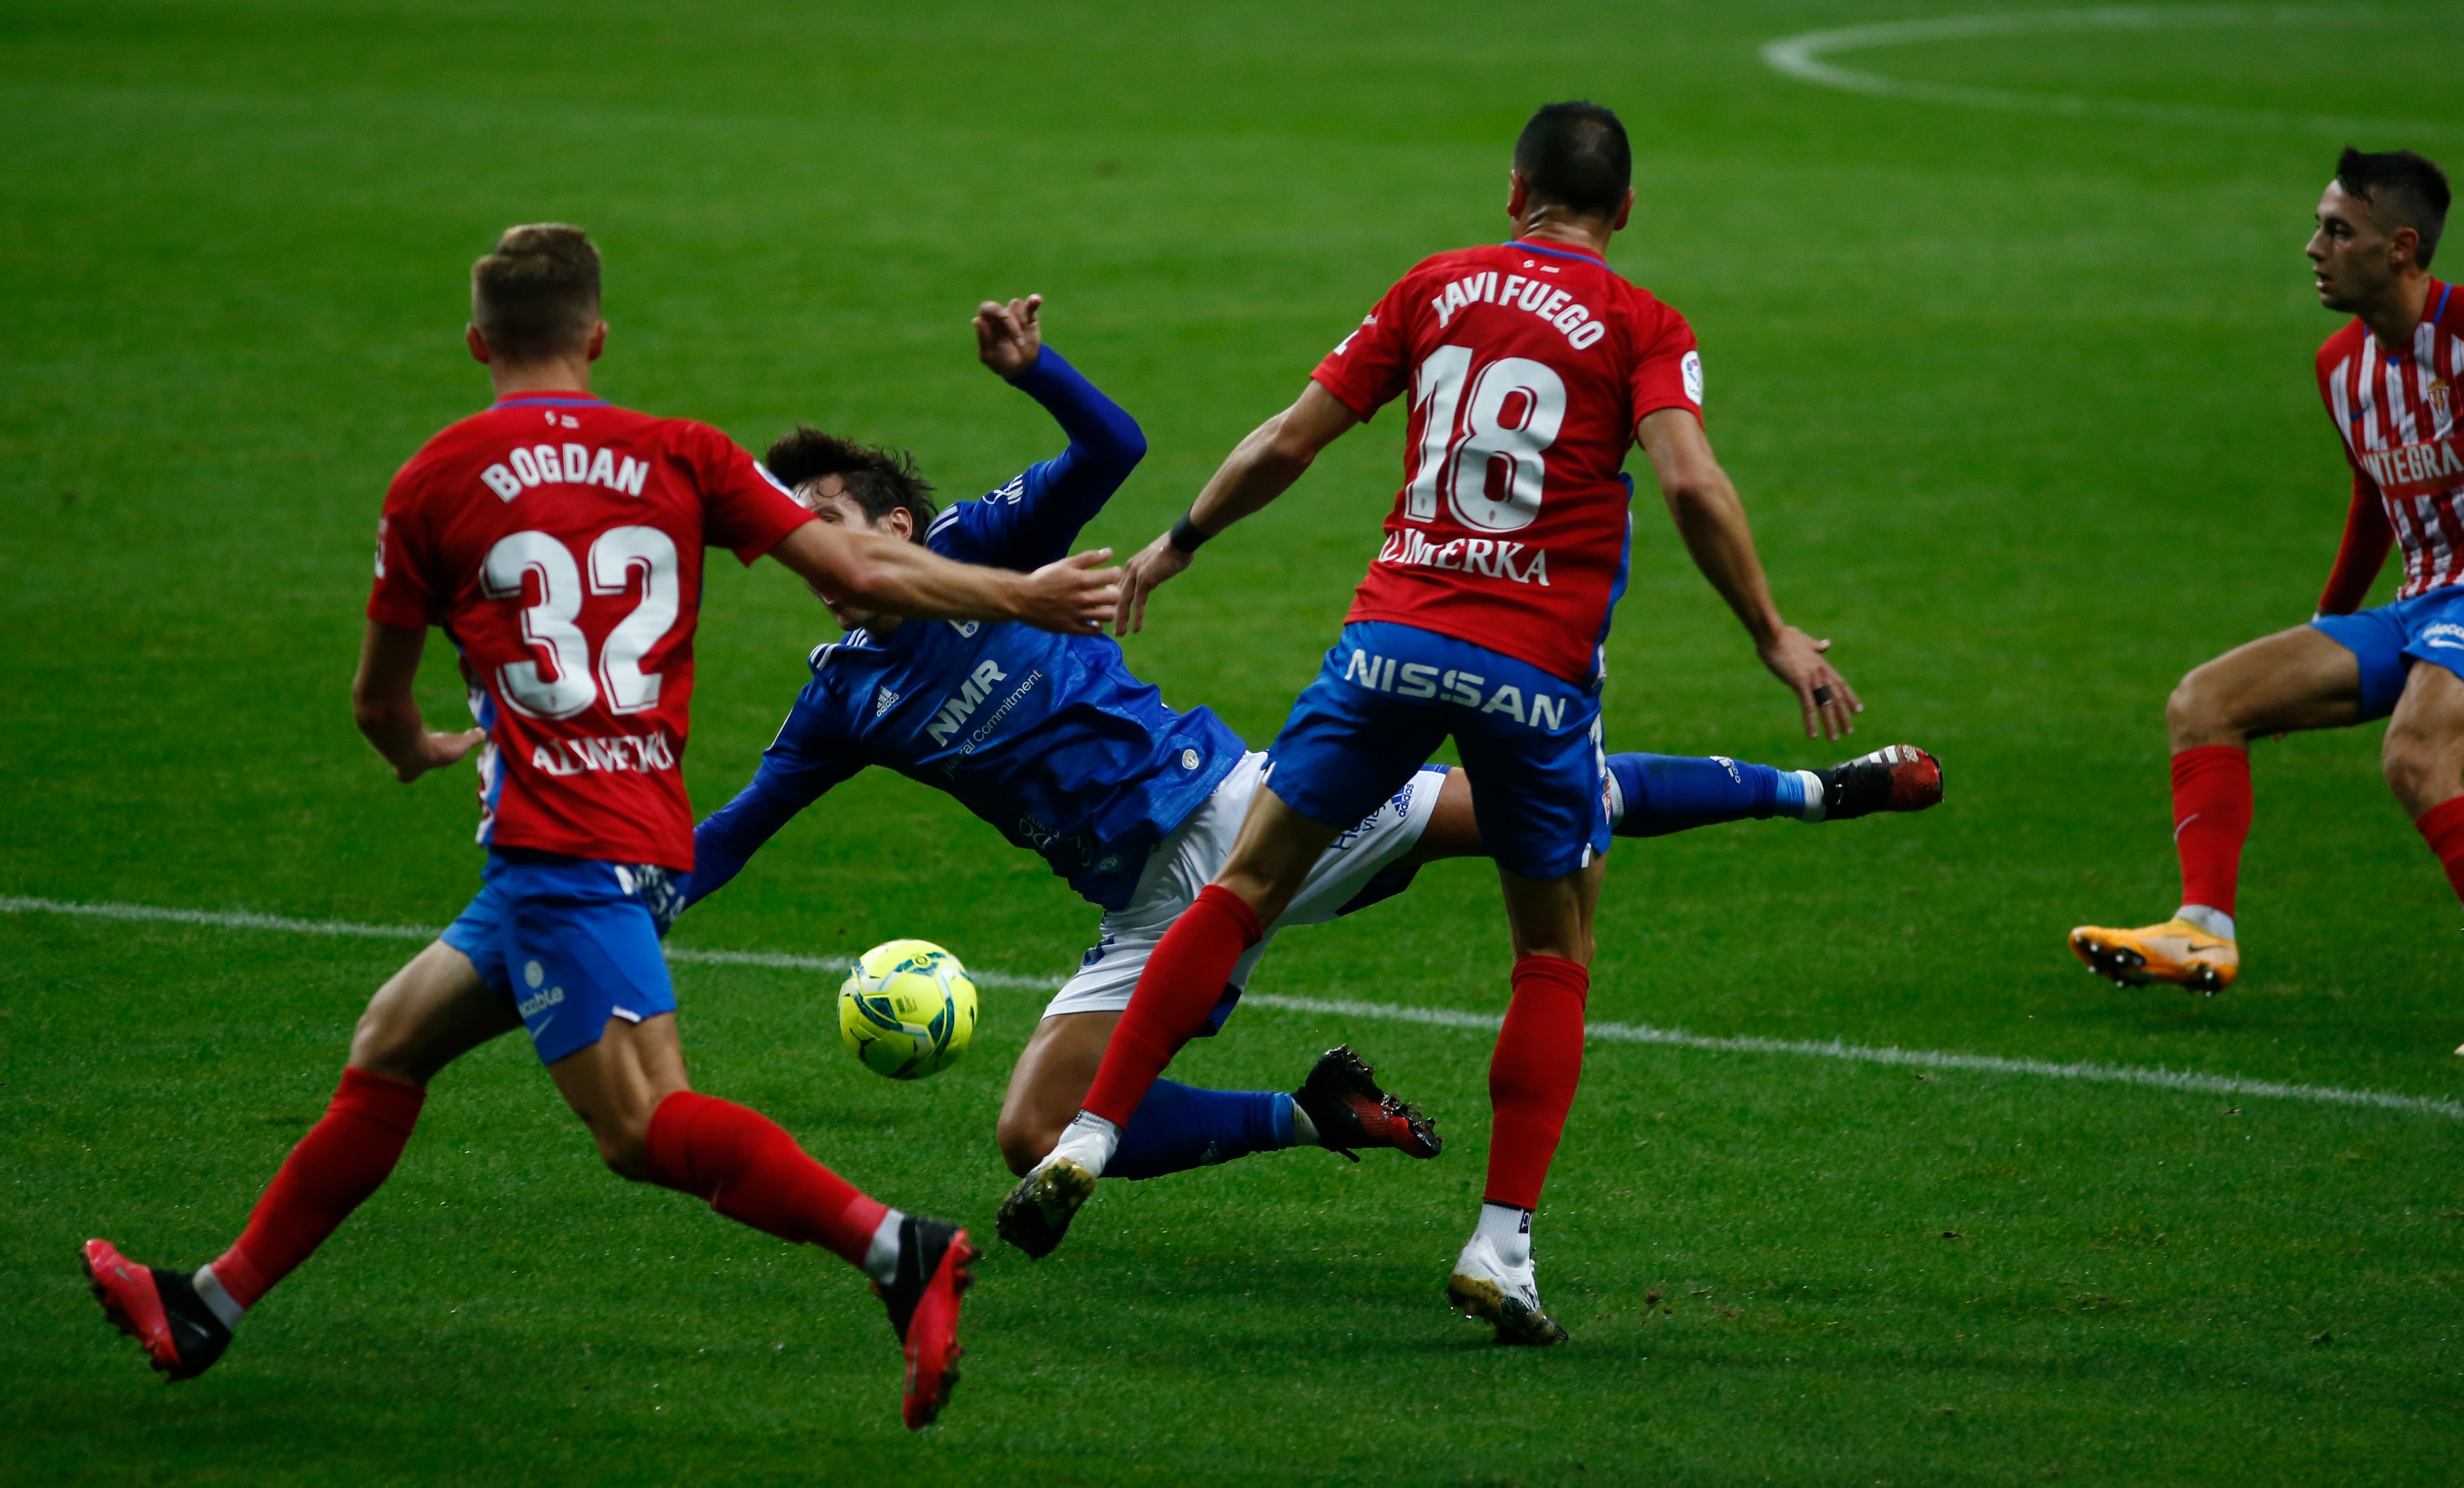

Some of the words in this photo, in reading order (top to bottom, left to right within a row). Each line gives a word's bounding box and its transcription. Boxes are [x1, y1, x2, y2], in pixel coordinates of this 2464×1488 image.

[1431, 271, 1497, 328] JAVI
[1498, 274, 1606, 350] FUEGO
[480, 443, 650, 504] BOGDAN
[1403, 344, 1567, 533] 18
[479, 525, 680, 720] 32
[876, 692, 899, 717] adidas
[925, 659, 1007, 747] NMR
[973, 669, 1043, 742] Commitment
[1345, 649, 1566, 730] NISSAN
[1399, 784, 1414, 817] adidas
